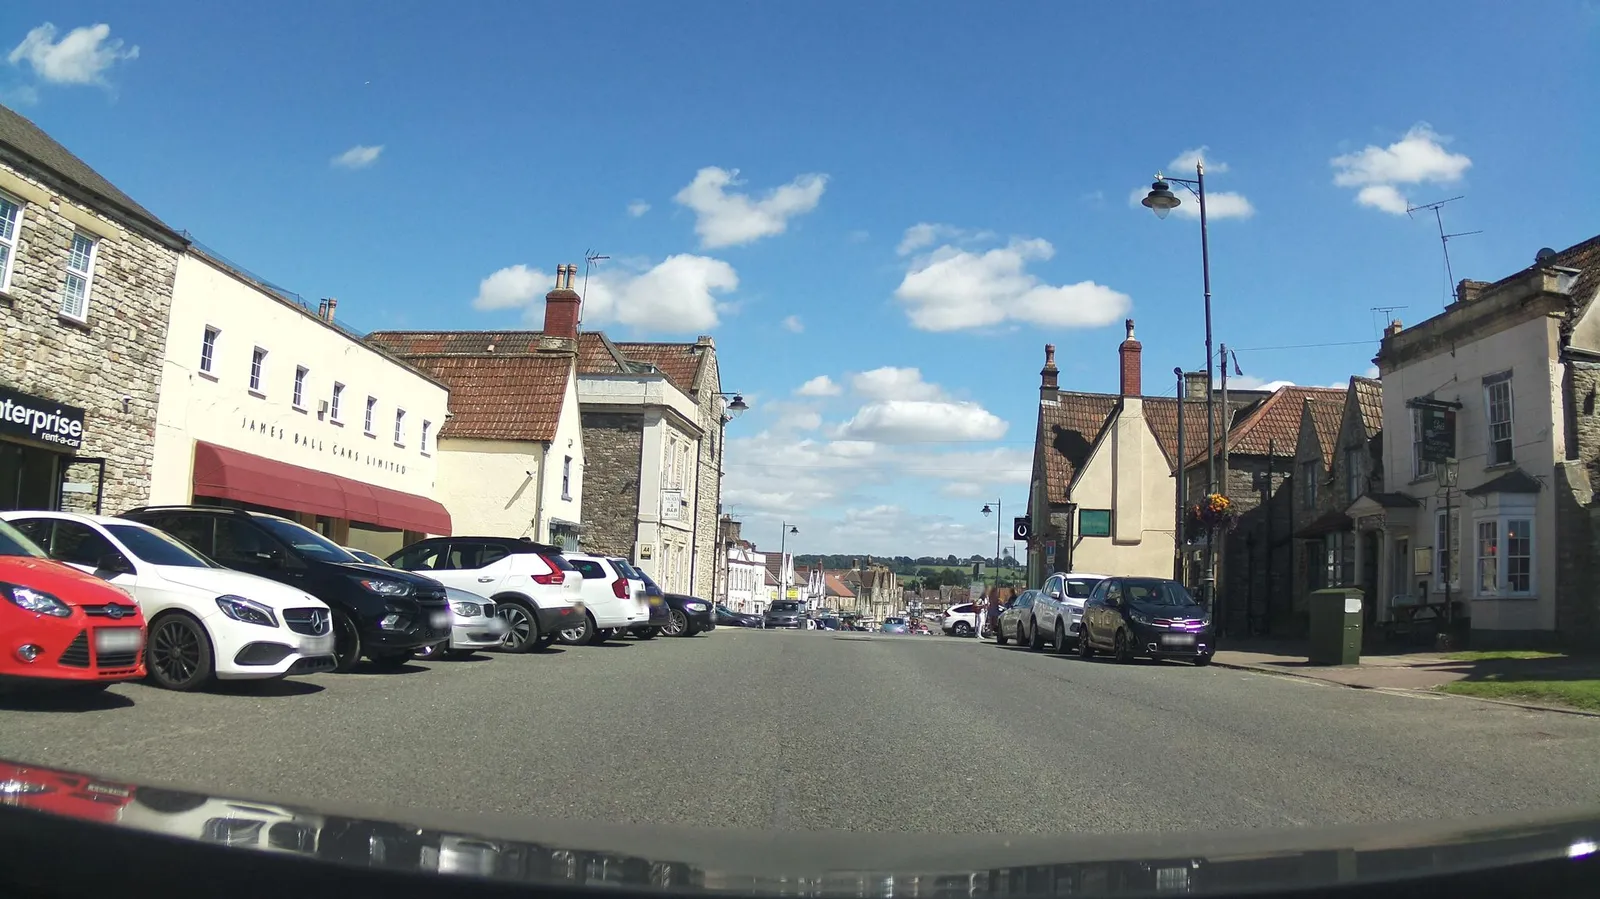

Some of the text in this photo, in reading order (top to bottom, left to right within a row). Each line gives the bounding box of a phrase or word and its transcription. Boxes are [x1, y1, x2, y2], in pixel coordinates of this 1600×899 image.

[41, 432, 80, 446] rent-a-car
[242, 417, 406, 474] JAMES BALL CARS LIMITED
